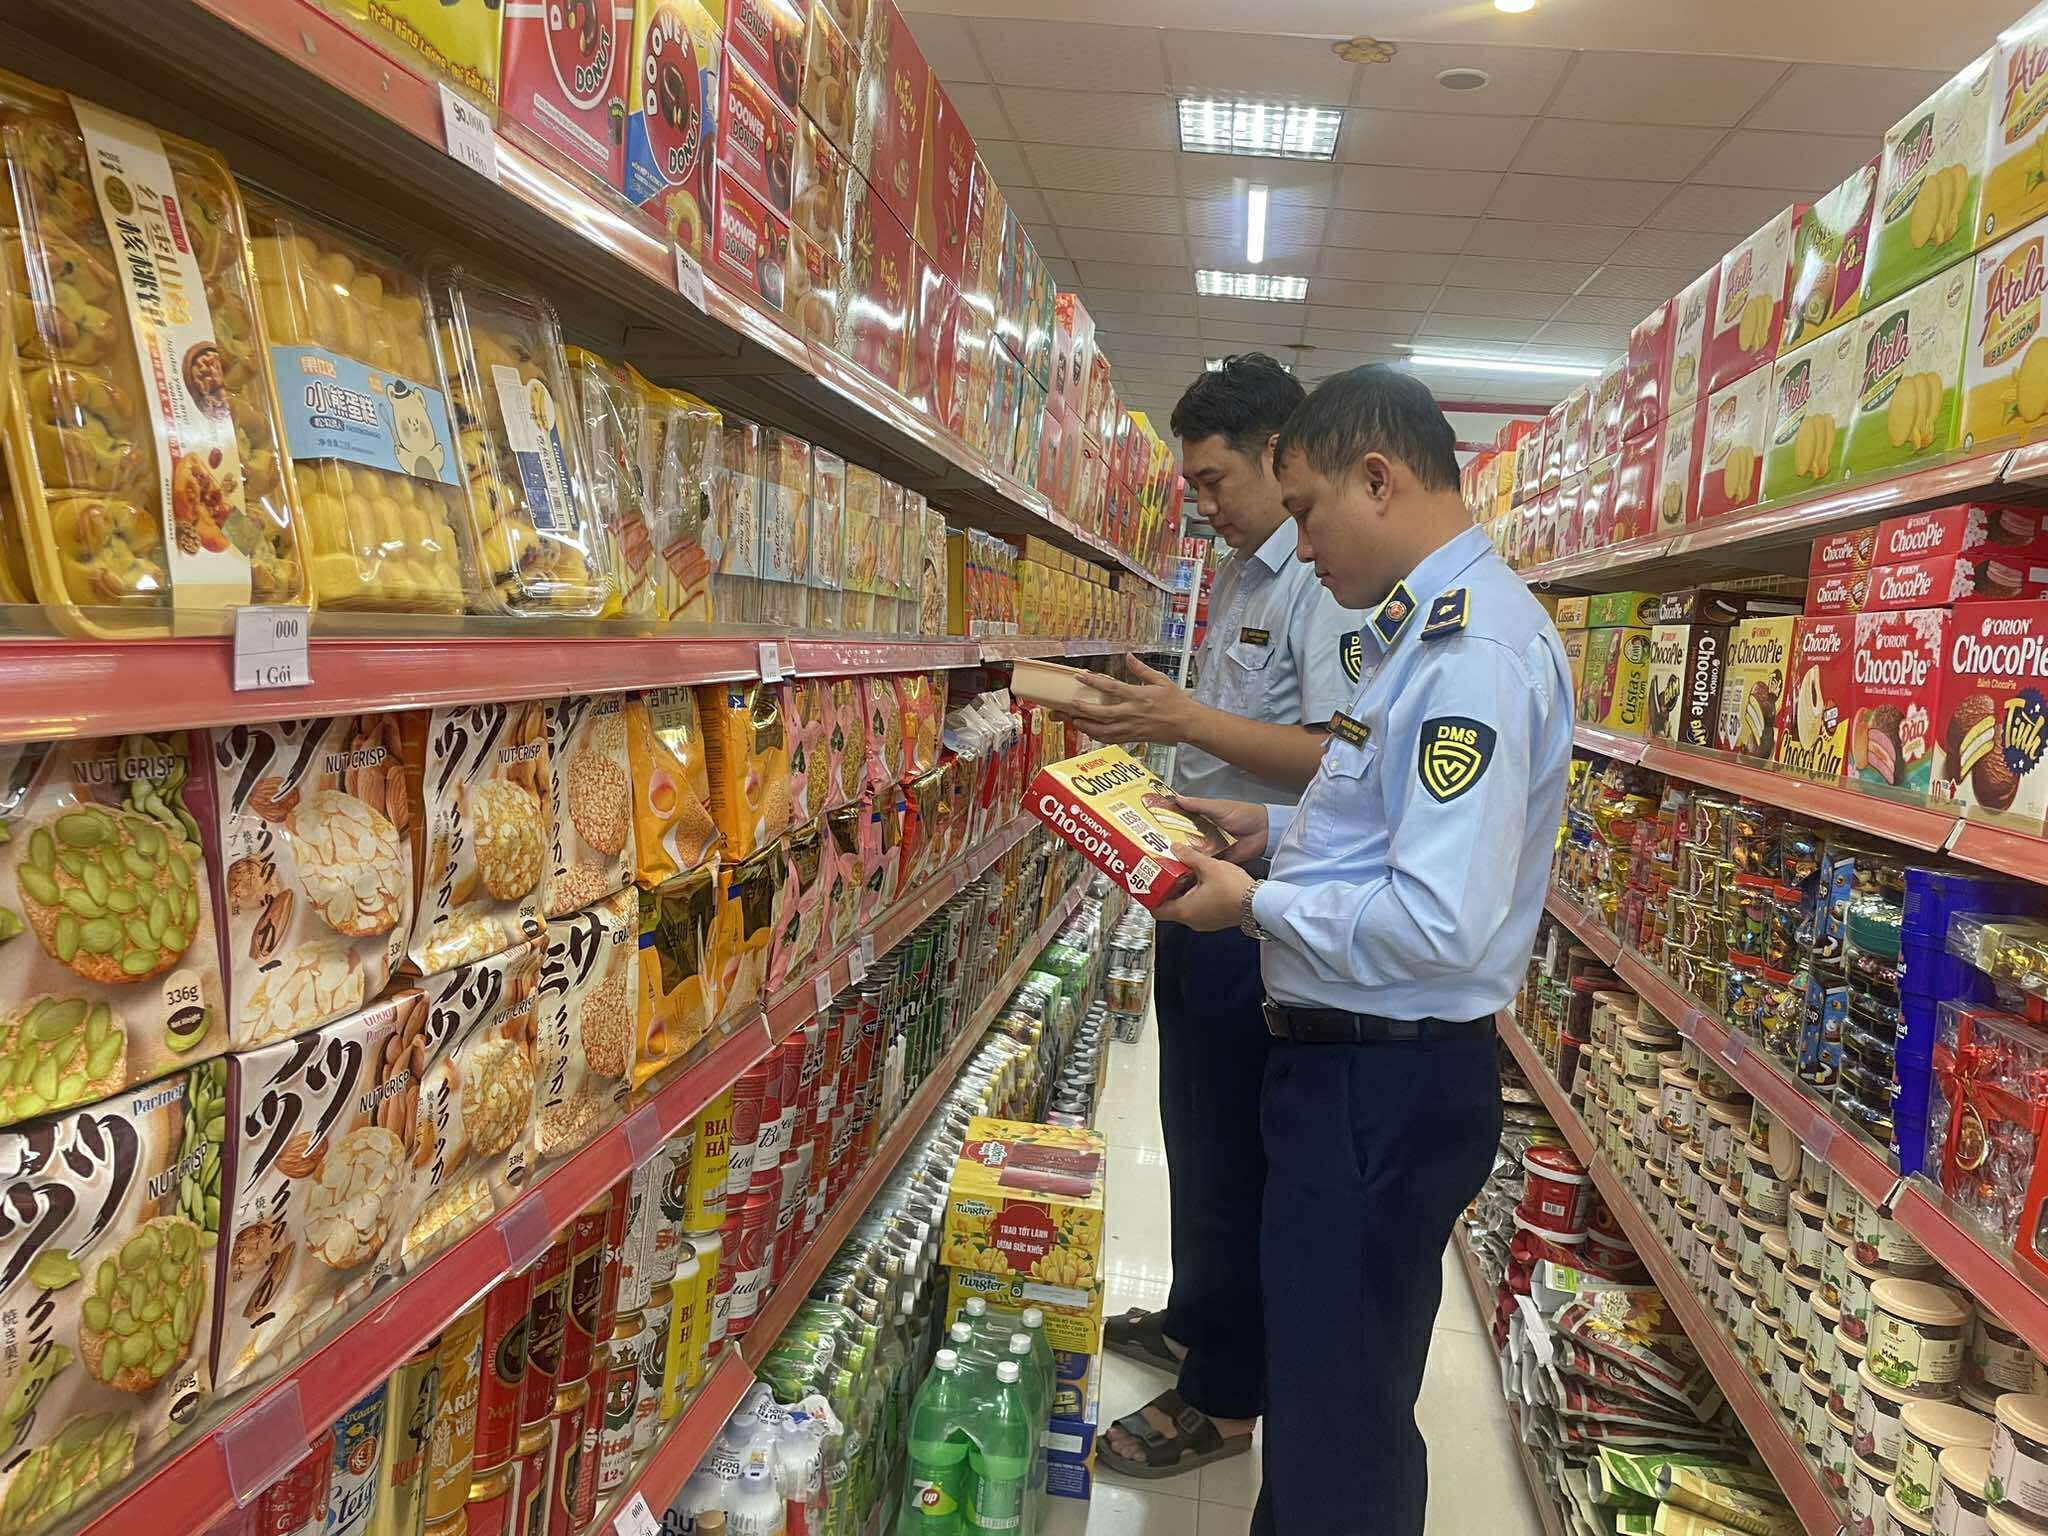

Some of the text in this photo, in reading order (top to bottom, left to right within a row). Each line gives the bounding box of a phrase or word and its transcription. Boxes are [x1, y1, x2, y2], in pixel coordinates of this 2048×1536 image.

[575, 24, 611, 93] DONUT
[728, 93, 765, 142] DOOWEE
[668, 103, 700, 174] DONUT
[731, 119, 760, 157] DONUT
[720, 208, 757, 251] DOOWEE
[724, 232, 751, 266] DONUT
[1977, 245, 2048, 347] Atela
[1858, 316, 1912, 400] Atela
[304, 381, 378, 428] 小熊蛋糕
[1890, 522, 1944, 554] ChocoPie
[1822, 543, 1854, 562] ChocoPie
[1816, 585, 1847, 603] ChocoPie
[1880, 571, 1932, 600] ChocoPie
[275, 618, 299, 639] 000
[1994, 618, 2031, 635] ORION
[1650, 641, 1683, 665] ChocoPie
[1737, 639, 1783, 664] ChocoPie
[1802, 632, 1841, 653] ChocoPie
[1884, 634, 1908, 648] ORION
[1855, 650, 1927, 686] ChocoPie
[1952, 634, 2048, 677] ChocoPie
[255, 665, 292, 686] 1 Gói
[1692, 636, 1717, 716] ChocoPie
[1710, 669, 1721, 696] ORION
[1620, 671, 1642, 724] Custas
[1437, 725, 1478, 746] DMS
[325, 747, 386, 774] NUT CRISP
[498, 744, 541, 764] NUT CRISP
[72, 753, 178, 784] NUT CRISP
[1071, 760, 1146, 797] ChocoPie
[1038, 794, 1126, 875] ChocoPie
[1079, 812, 1109, 838] ORION
[1139, 862, 1156, 878] LESS
[519, 906, 536, 918] 336g
[165, 984, 199, 1006] 336g
[490, 1010, 508, 1028] NUT
[132, 1082, 186, 1116] Partner
[359, 1068, 412, 1113] NUT CRISP
[704, 1118, 728, 1137] BIA
[704, 1136, 725, 1158] HÀ
[149, 1141, 209, 1201] NUT CRISP
[955, 1202, 993, 1218] Twister
[1000, 1224, 1018, 1236] TRAO
[957, 1273, 1007, 1293] Twister
